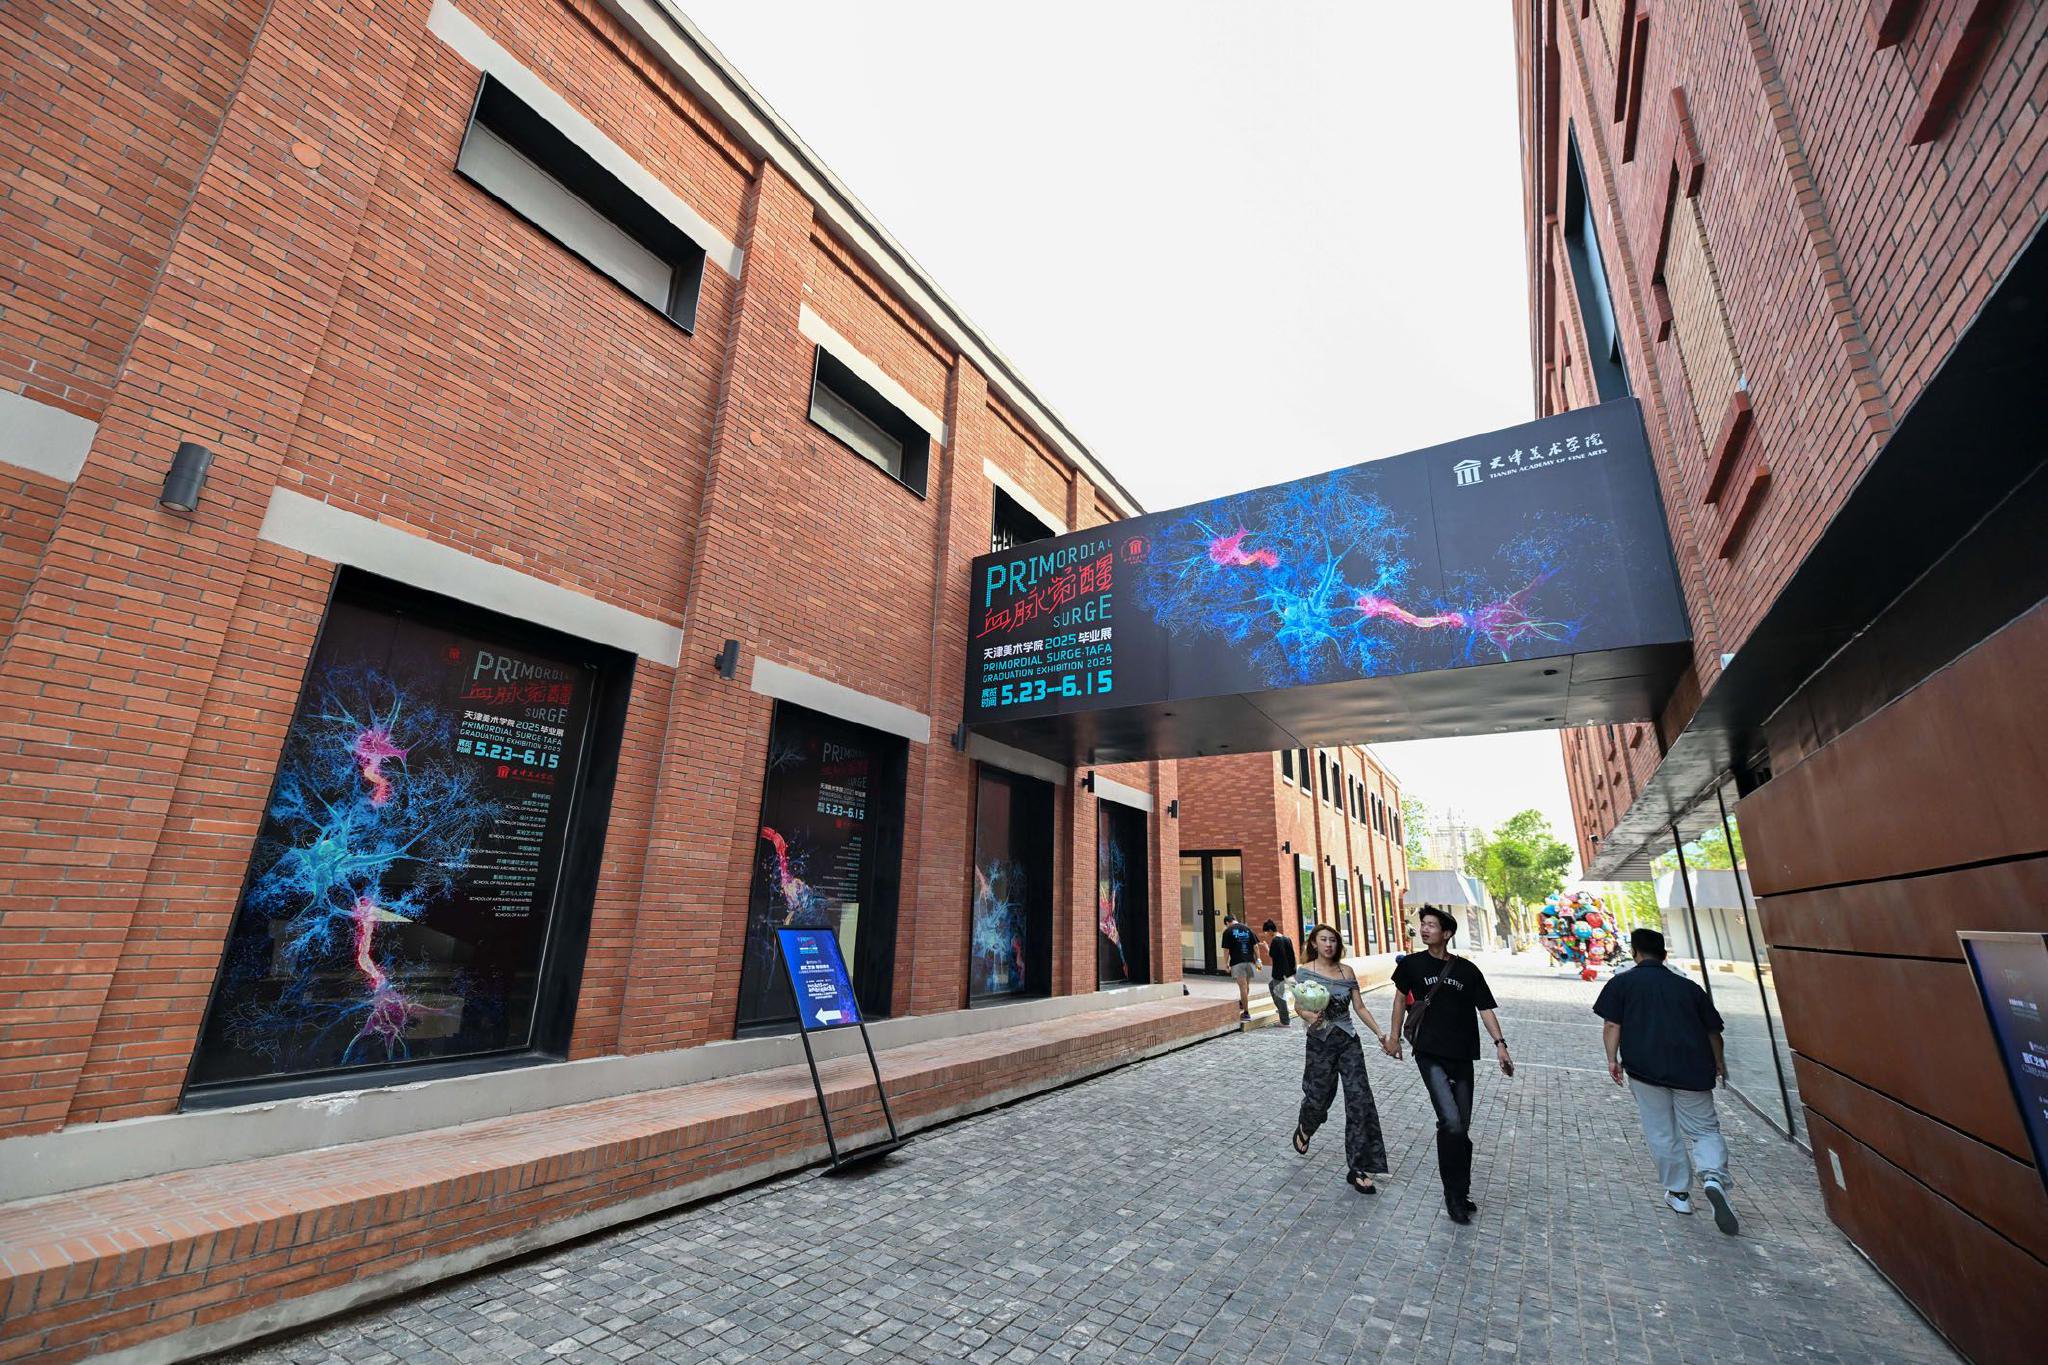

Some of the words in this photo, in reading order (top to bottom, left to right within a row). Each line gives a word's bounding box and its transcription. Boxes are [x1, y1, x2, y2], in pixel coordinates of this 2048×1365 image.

[1489, 432, 1604, 469] 天津美术学院
[1489, 469, 1518, 479] TIANJIN
[1519, 460, 1555, 472] ACADEMY
[1568, 453, 1586, 461] FINE
[1587, 448, 1608, 457] ARTS
[985, 539, 1113, 608] PRIMORDIAL
[1053, 594, 1113, 628] SURGE
[1044, 633, 1077, 650] 2025
[982, 667, 1034, 683] GRADUATION
[1036, 662, 1083, 675] EXHIBITION
[1086, 655, 1112, 668] 2025
[983, 655, 1043, 672] PRIMORDIAL
[524, 706, 568, 724] SURGE
[459, 728, 505, 742] GRADUATION
[506, 737, 542, 749] EXHIBITION
[461, 721, 513, 737] PRIMORDIAL
